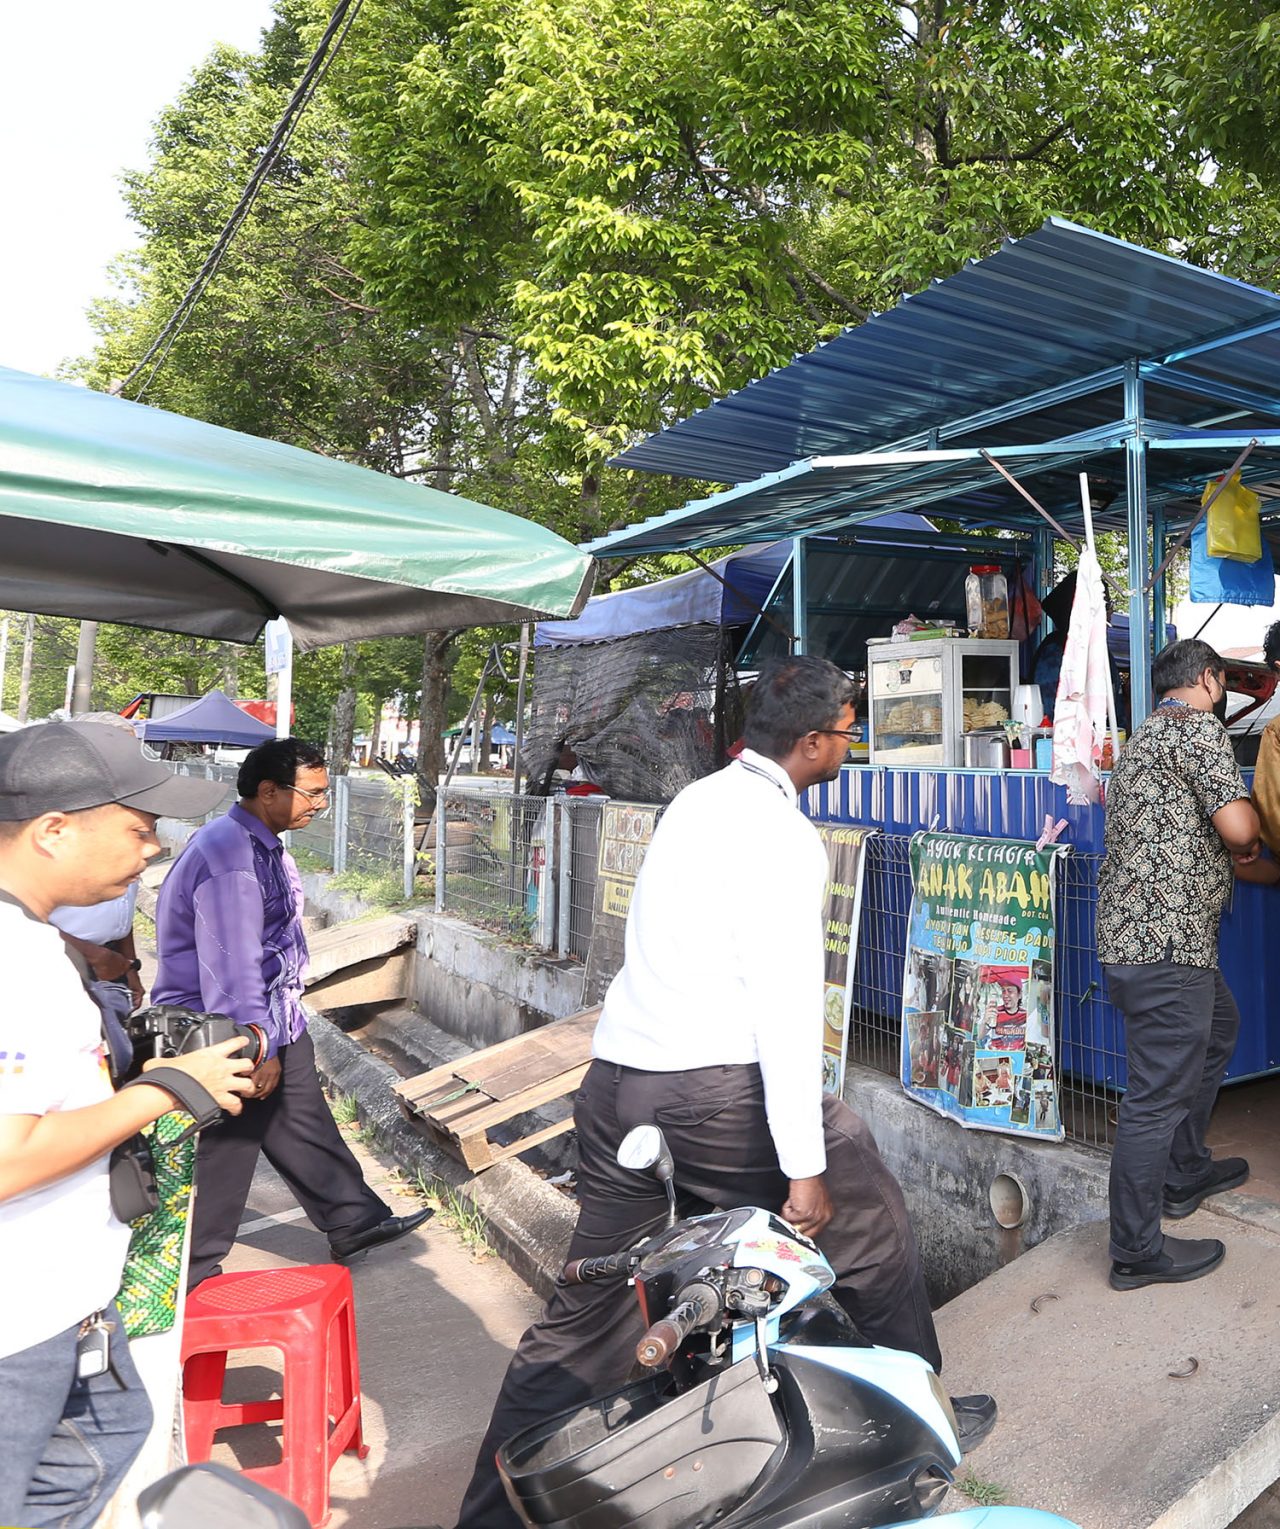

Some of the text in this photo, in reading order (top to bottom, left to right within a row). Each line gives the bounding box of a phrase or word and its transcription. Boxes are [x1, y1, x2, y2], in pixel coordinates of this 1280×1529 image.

[918, 862, 1050, 912] ANAK ABAH
[995, 945, 1029, 963] PIOR
